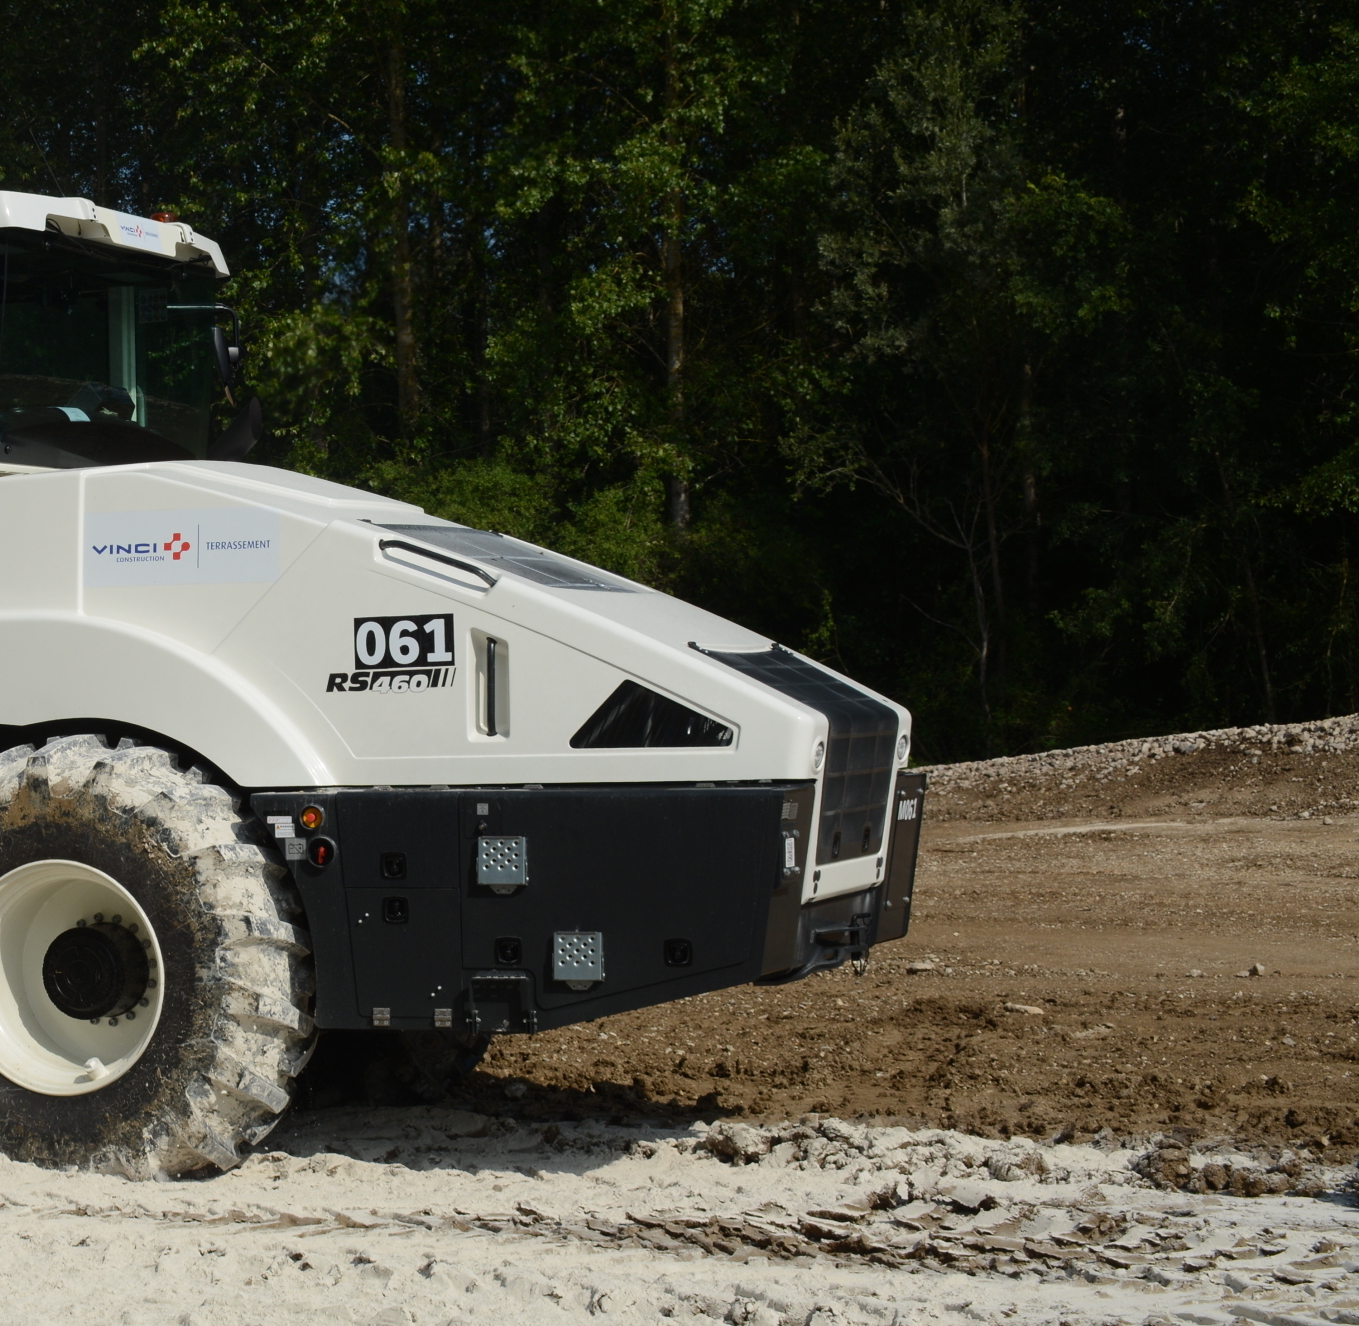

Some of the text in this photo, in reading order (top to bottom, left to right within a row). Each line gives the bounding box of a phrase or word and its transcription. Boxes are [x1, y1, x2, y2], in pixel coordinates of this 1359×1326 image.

[92, 543, 157, 555] VINCI
[206, 539, 271, 551] TERRASSEMENT
[116, 555, 165, 563] CONSTRUCTION
[356, 618, 453, 666] 061
[897, 797, 918, 821] M061
